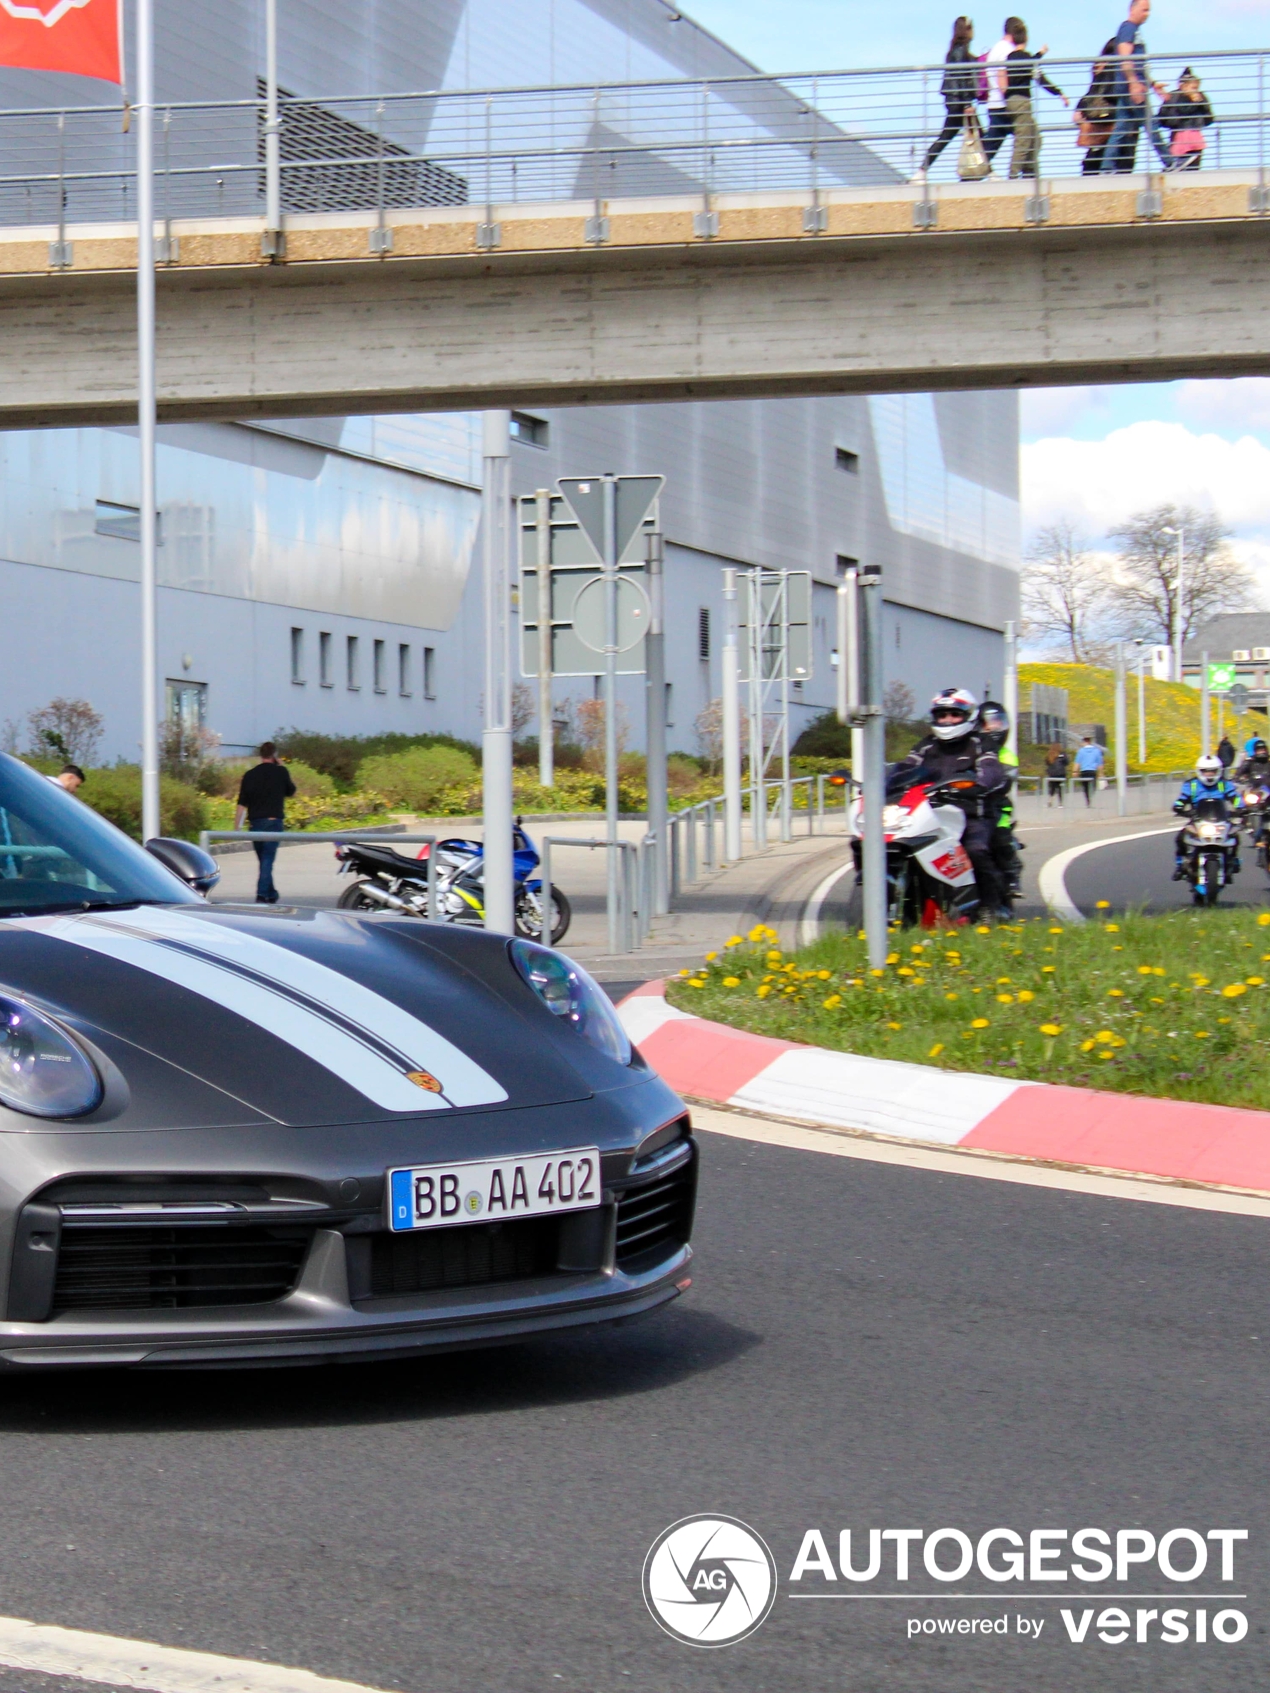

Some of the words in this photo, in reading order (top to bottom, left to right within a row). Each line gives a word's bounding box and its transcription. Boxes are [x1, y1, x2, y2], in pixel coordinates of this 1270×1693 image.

[414, 1174, 460, 1220] BB
[488, 1166, 530, 1212] AA
[538, 1157, 595, 1205] 402
[398, 1206, 407, 1218] D
